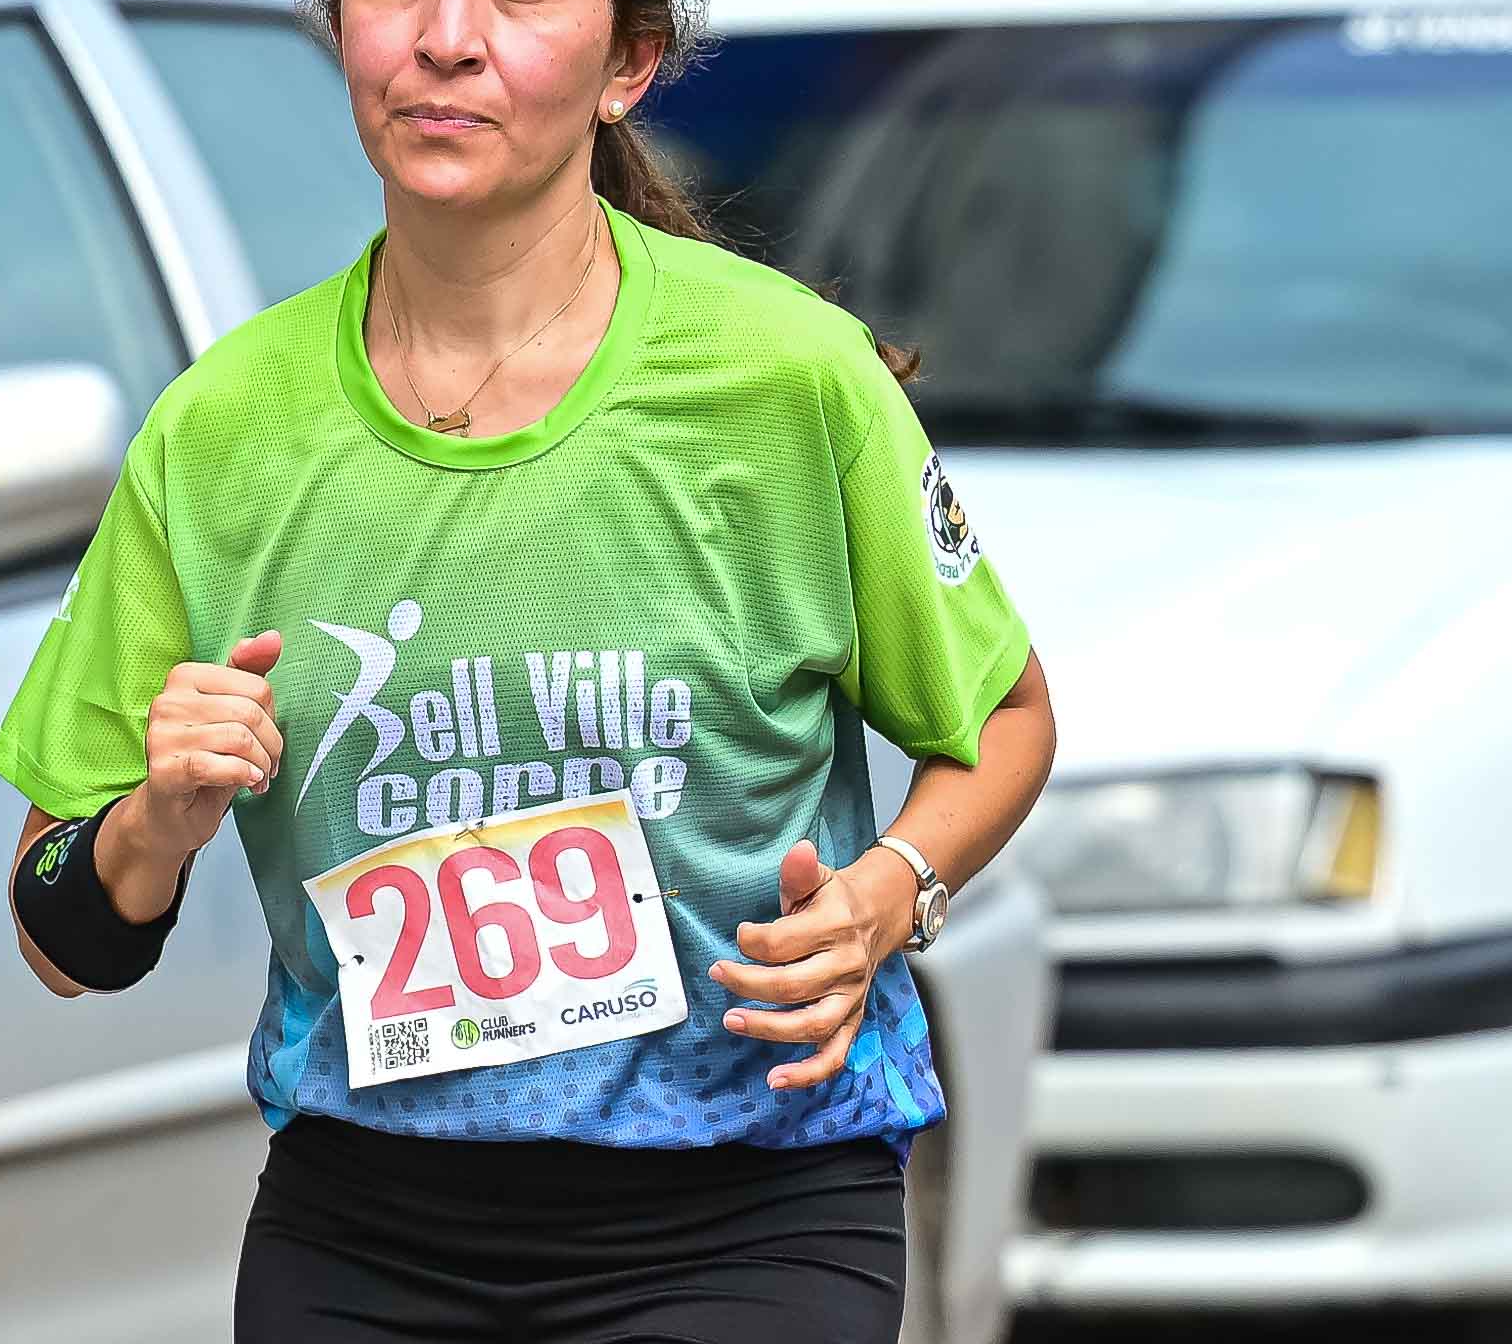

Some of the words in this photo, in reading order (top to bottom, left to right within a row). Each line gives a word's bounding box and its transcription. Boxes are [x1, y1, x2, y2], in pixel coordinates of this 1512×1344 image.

[524, 649, 693, 752] Ville
[345, 826, 637, 1020] 269
[480, 1016, 509, 1030] CLUB
[560, 990, 657, 1025] CARUSO
[482, 1022, 537, 1042] RUNNER'S
